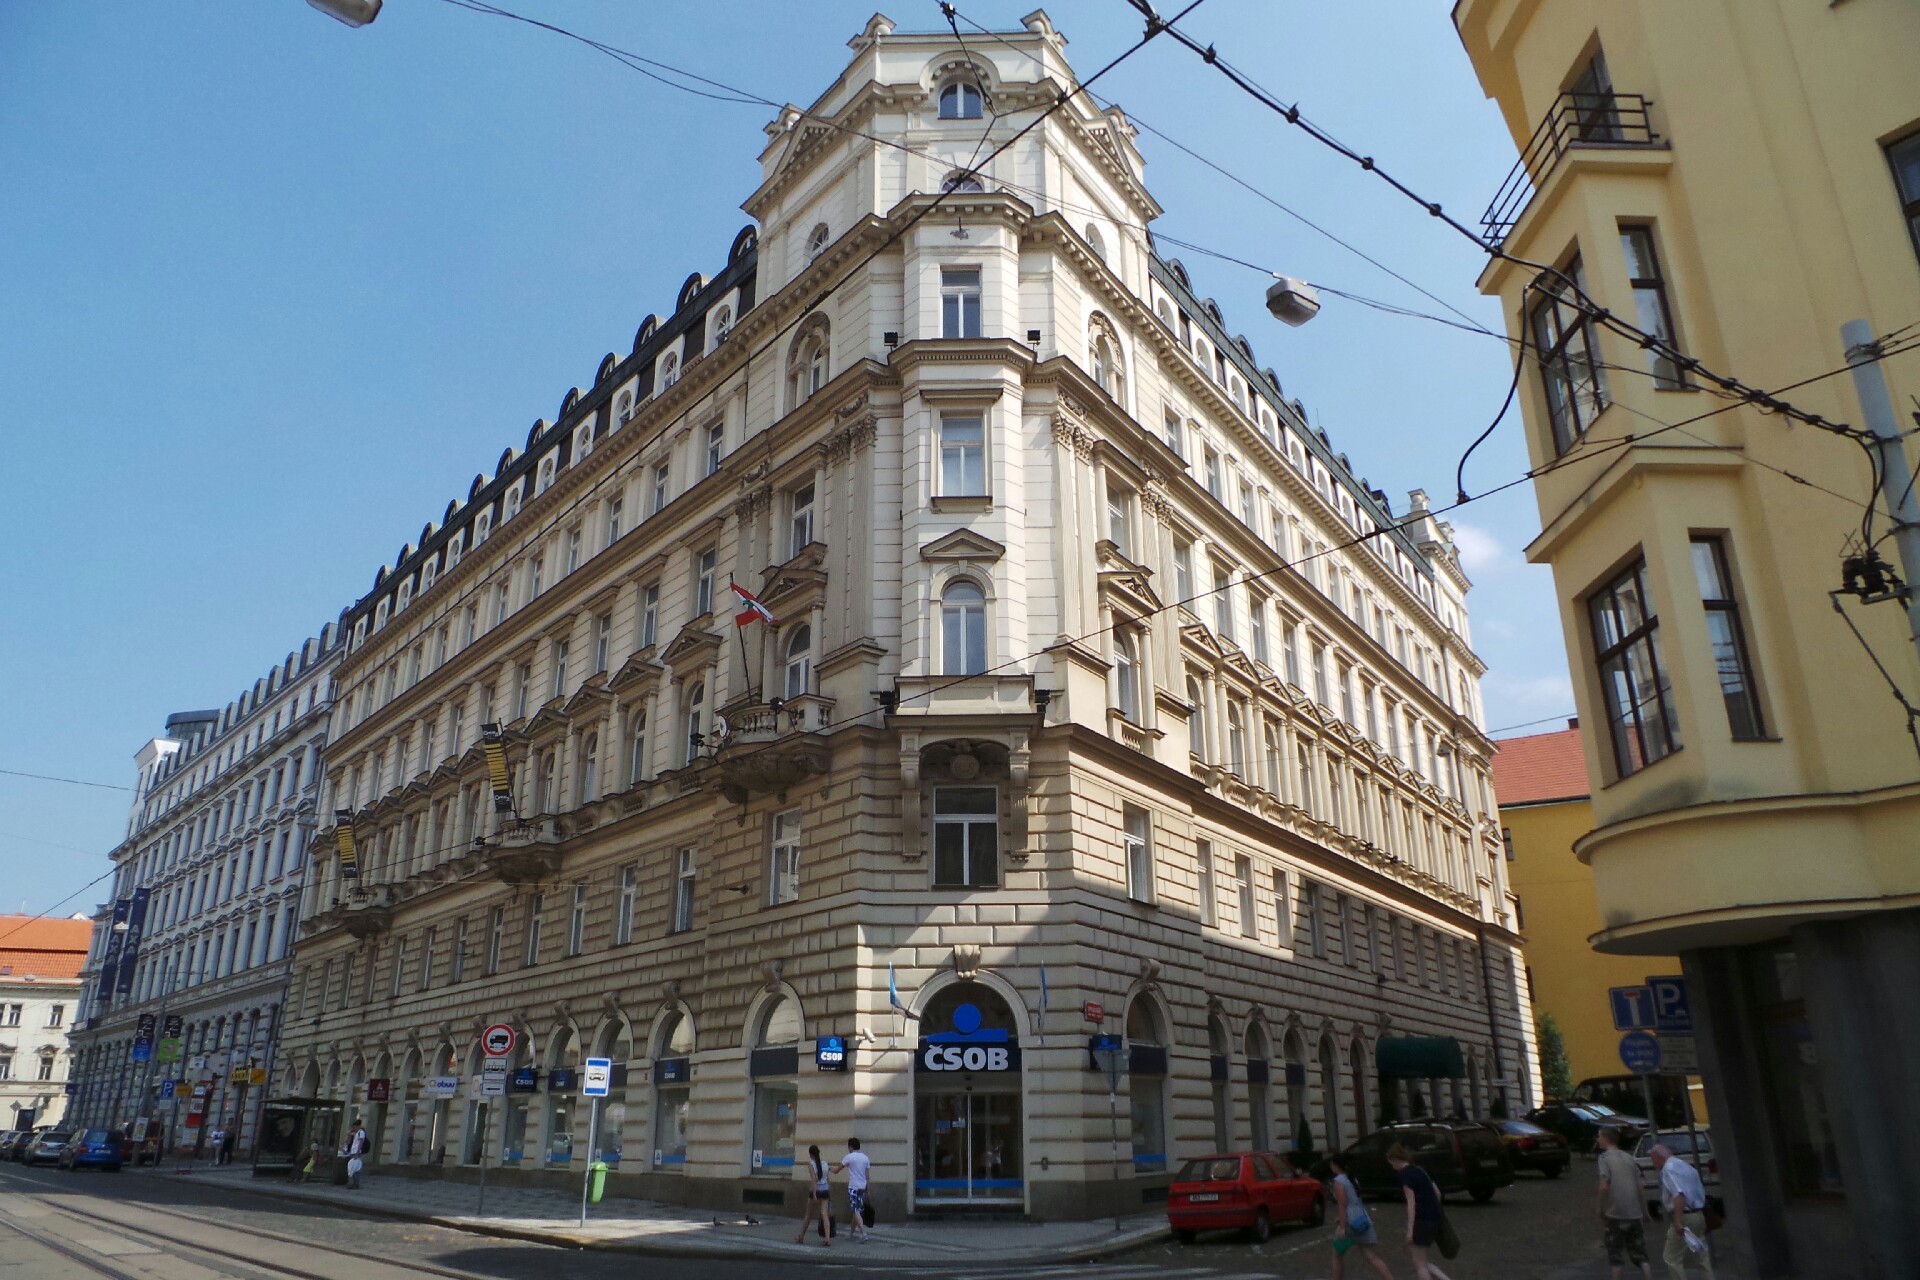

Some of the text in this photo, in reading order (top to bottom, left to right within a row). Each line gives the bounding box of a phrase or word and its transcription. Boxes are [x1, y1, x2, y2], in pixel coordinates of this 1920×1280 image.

[105, 934, 121, 965] AXA
[124, 924, 140, 955] AXA
[1656, 983, 1681, 1015] P
[924, 1044, 1009, 1071] ČSOB
